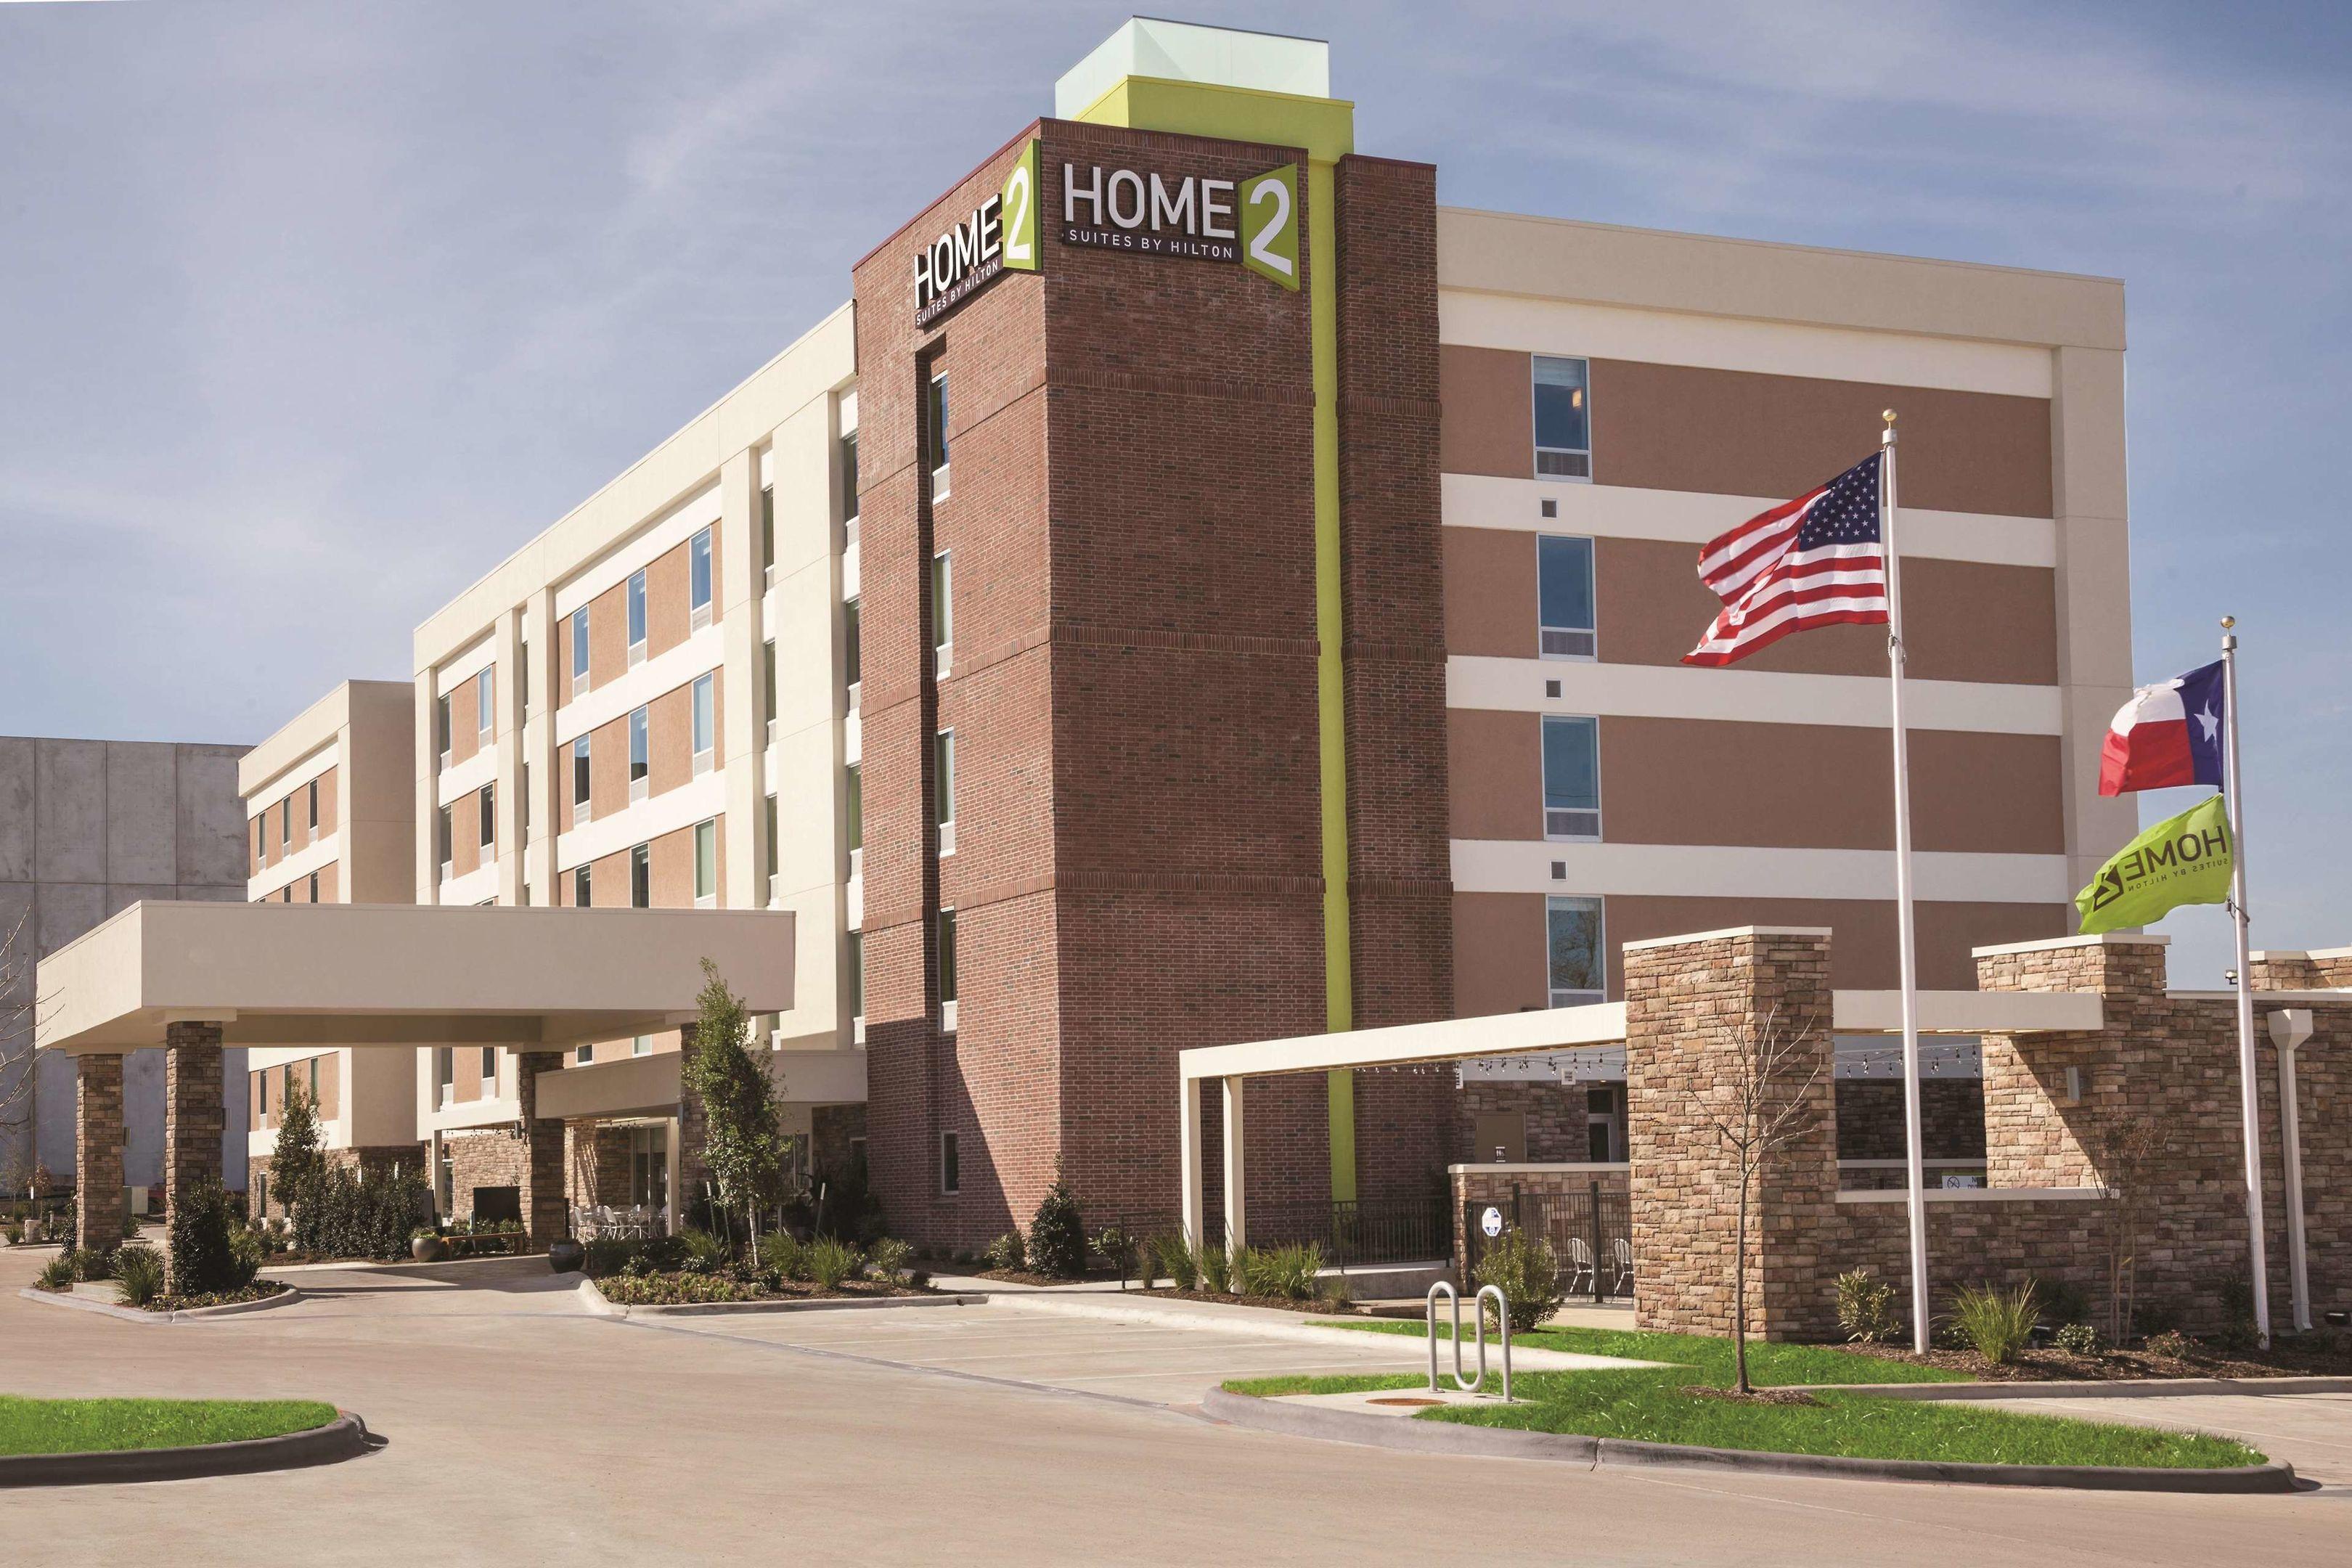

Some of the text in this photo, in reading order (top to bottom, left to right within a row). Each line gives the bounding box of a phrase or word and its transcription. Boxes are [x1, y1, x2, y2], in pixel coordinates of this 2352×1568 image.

[914, 166, 1030, 309] HOME 2
[1064, 163, 1292, 276] HOME 2
[1069, 229, 1232, 258] SUITES BY HILTON
[916, 259, 998, 325] SUITES BY HILTON
